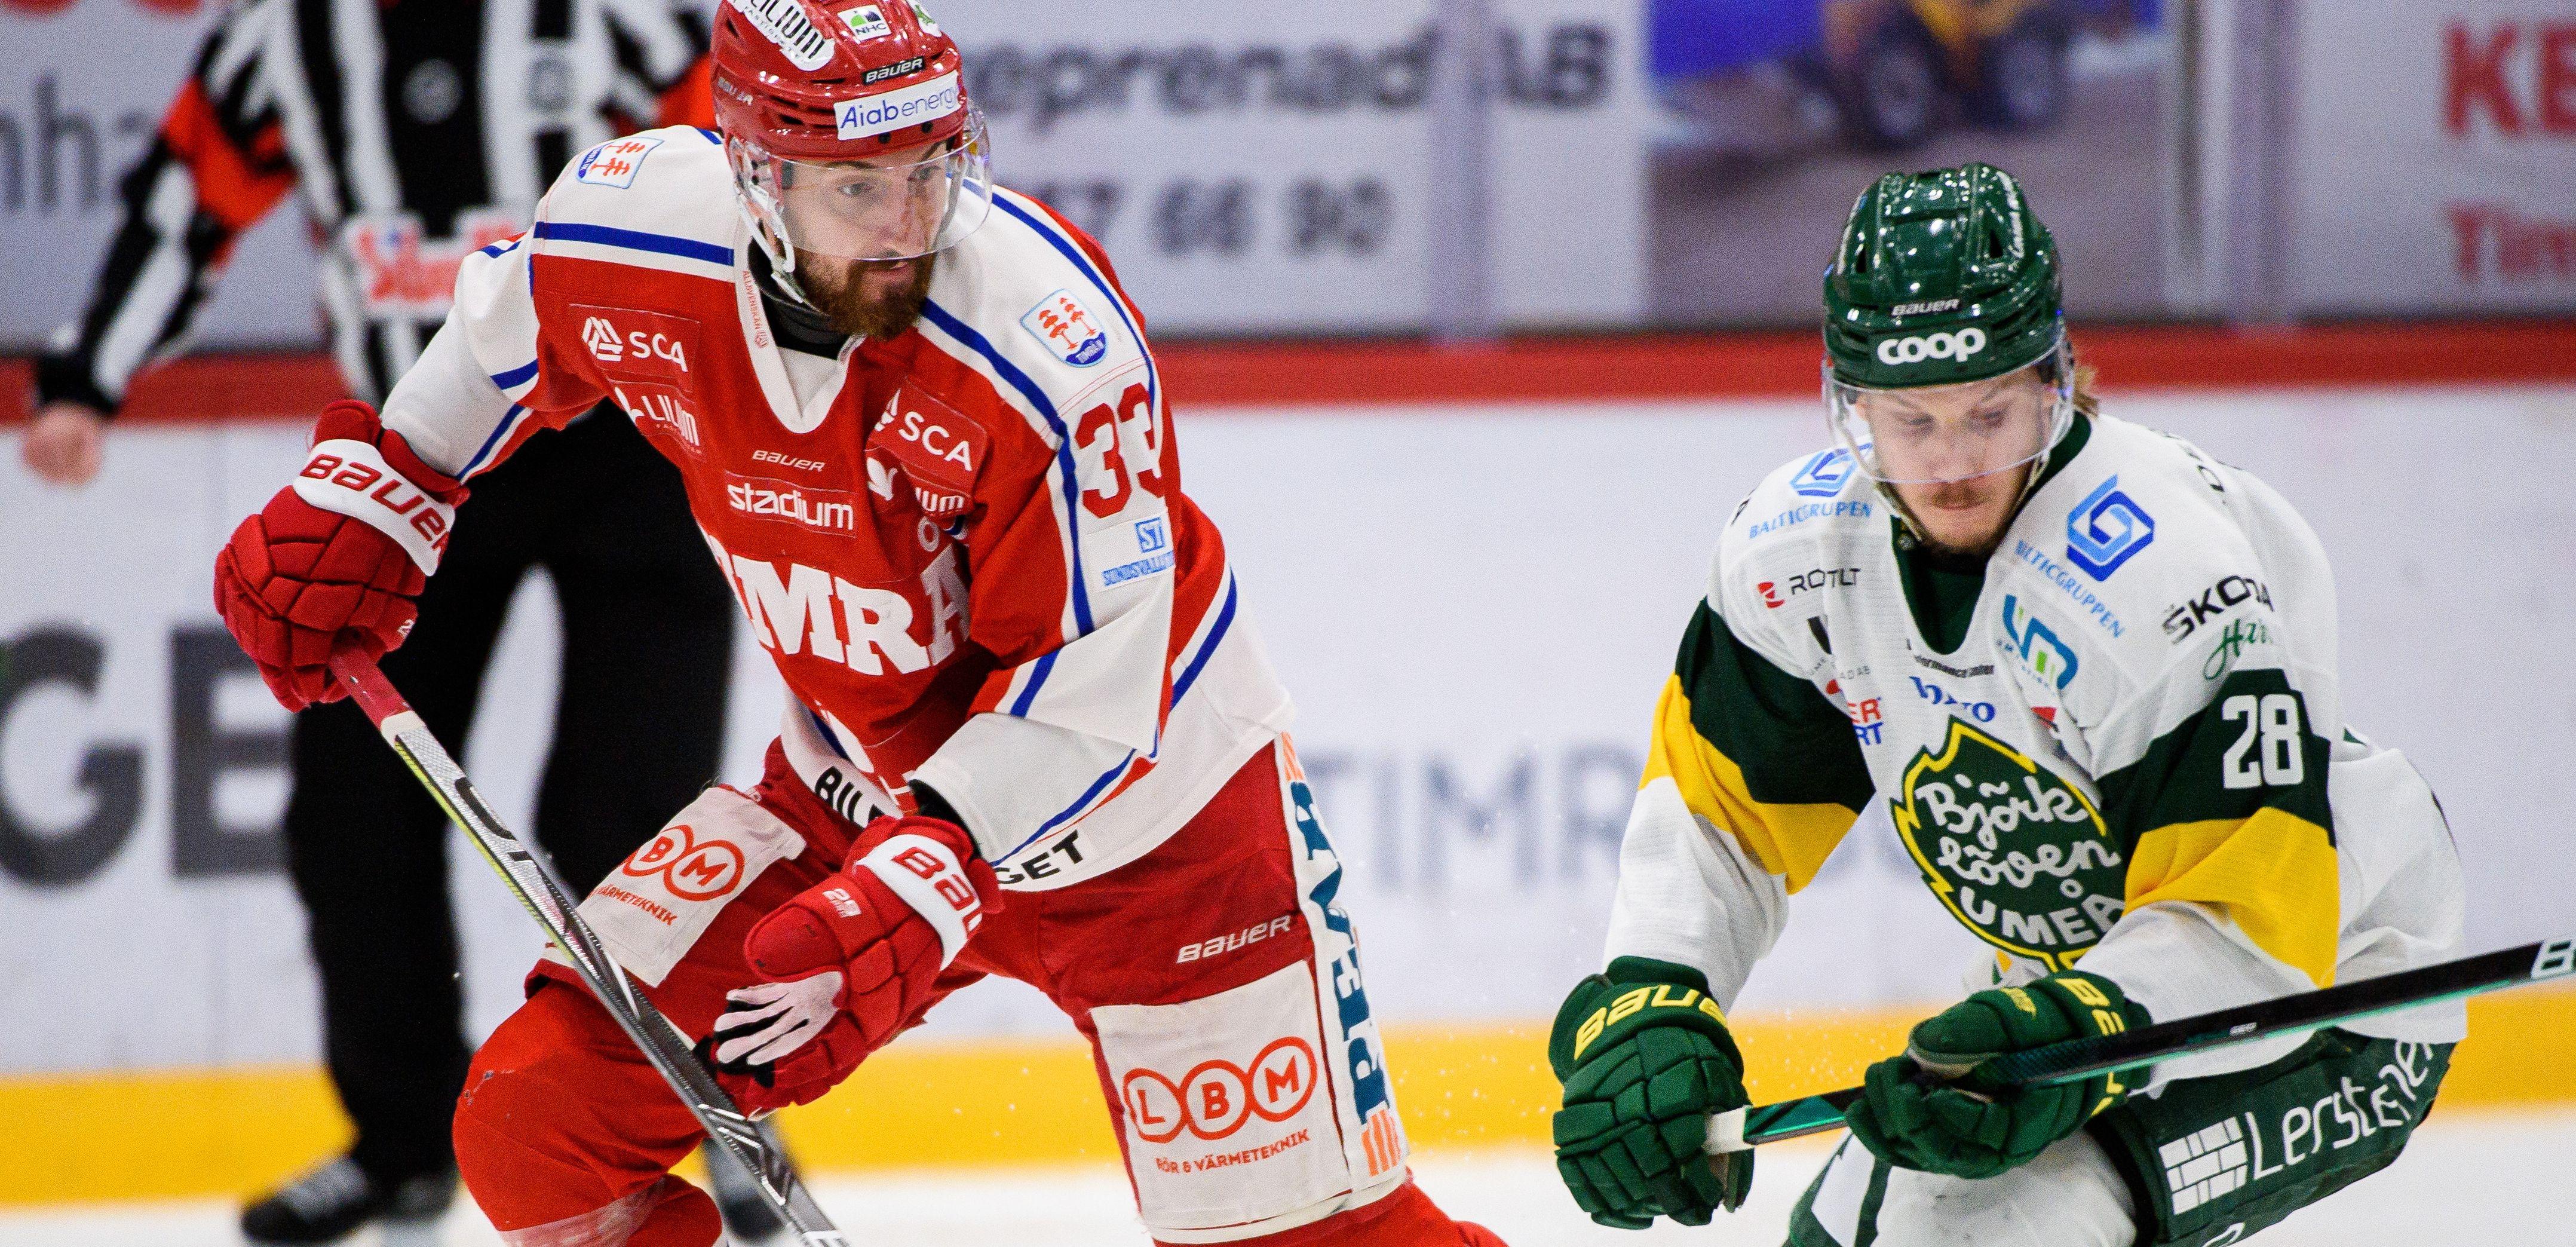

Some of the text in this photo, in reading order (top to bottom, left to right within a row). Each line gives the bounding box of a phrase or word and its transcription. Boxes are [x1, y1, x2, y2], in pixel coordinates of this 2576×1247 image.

[750, 0, 826, 59] ILIUM
[855, 23, 887, 35] NHC
[628, 331, 688, 372] SCA
[1877, 327, 1986, 365] coop
[898, 410, 973, 471] SCA
[1074, 383, 1165, 519] 33
[727, 483, 854, 531] stadium
[2222, 693, 2304, 789] 28
[1961, 879, 2125, 946] UMEÅ
[1176, 915, 1292, 964] BAUER
[2531, 940, 2576, 979] B
[2245, 1039, 2434, 1180] Lerstene
[1194, 1127, 1311, 1173] VÄRMETEKNIK
